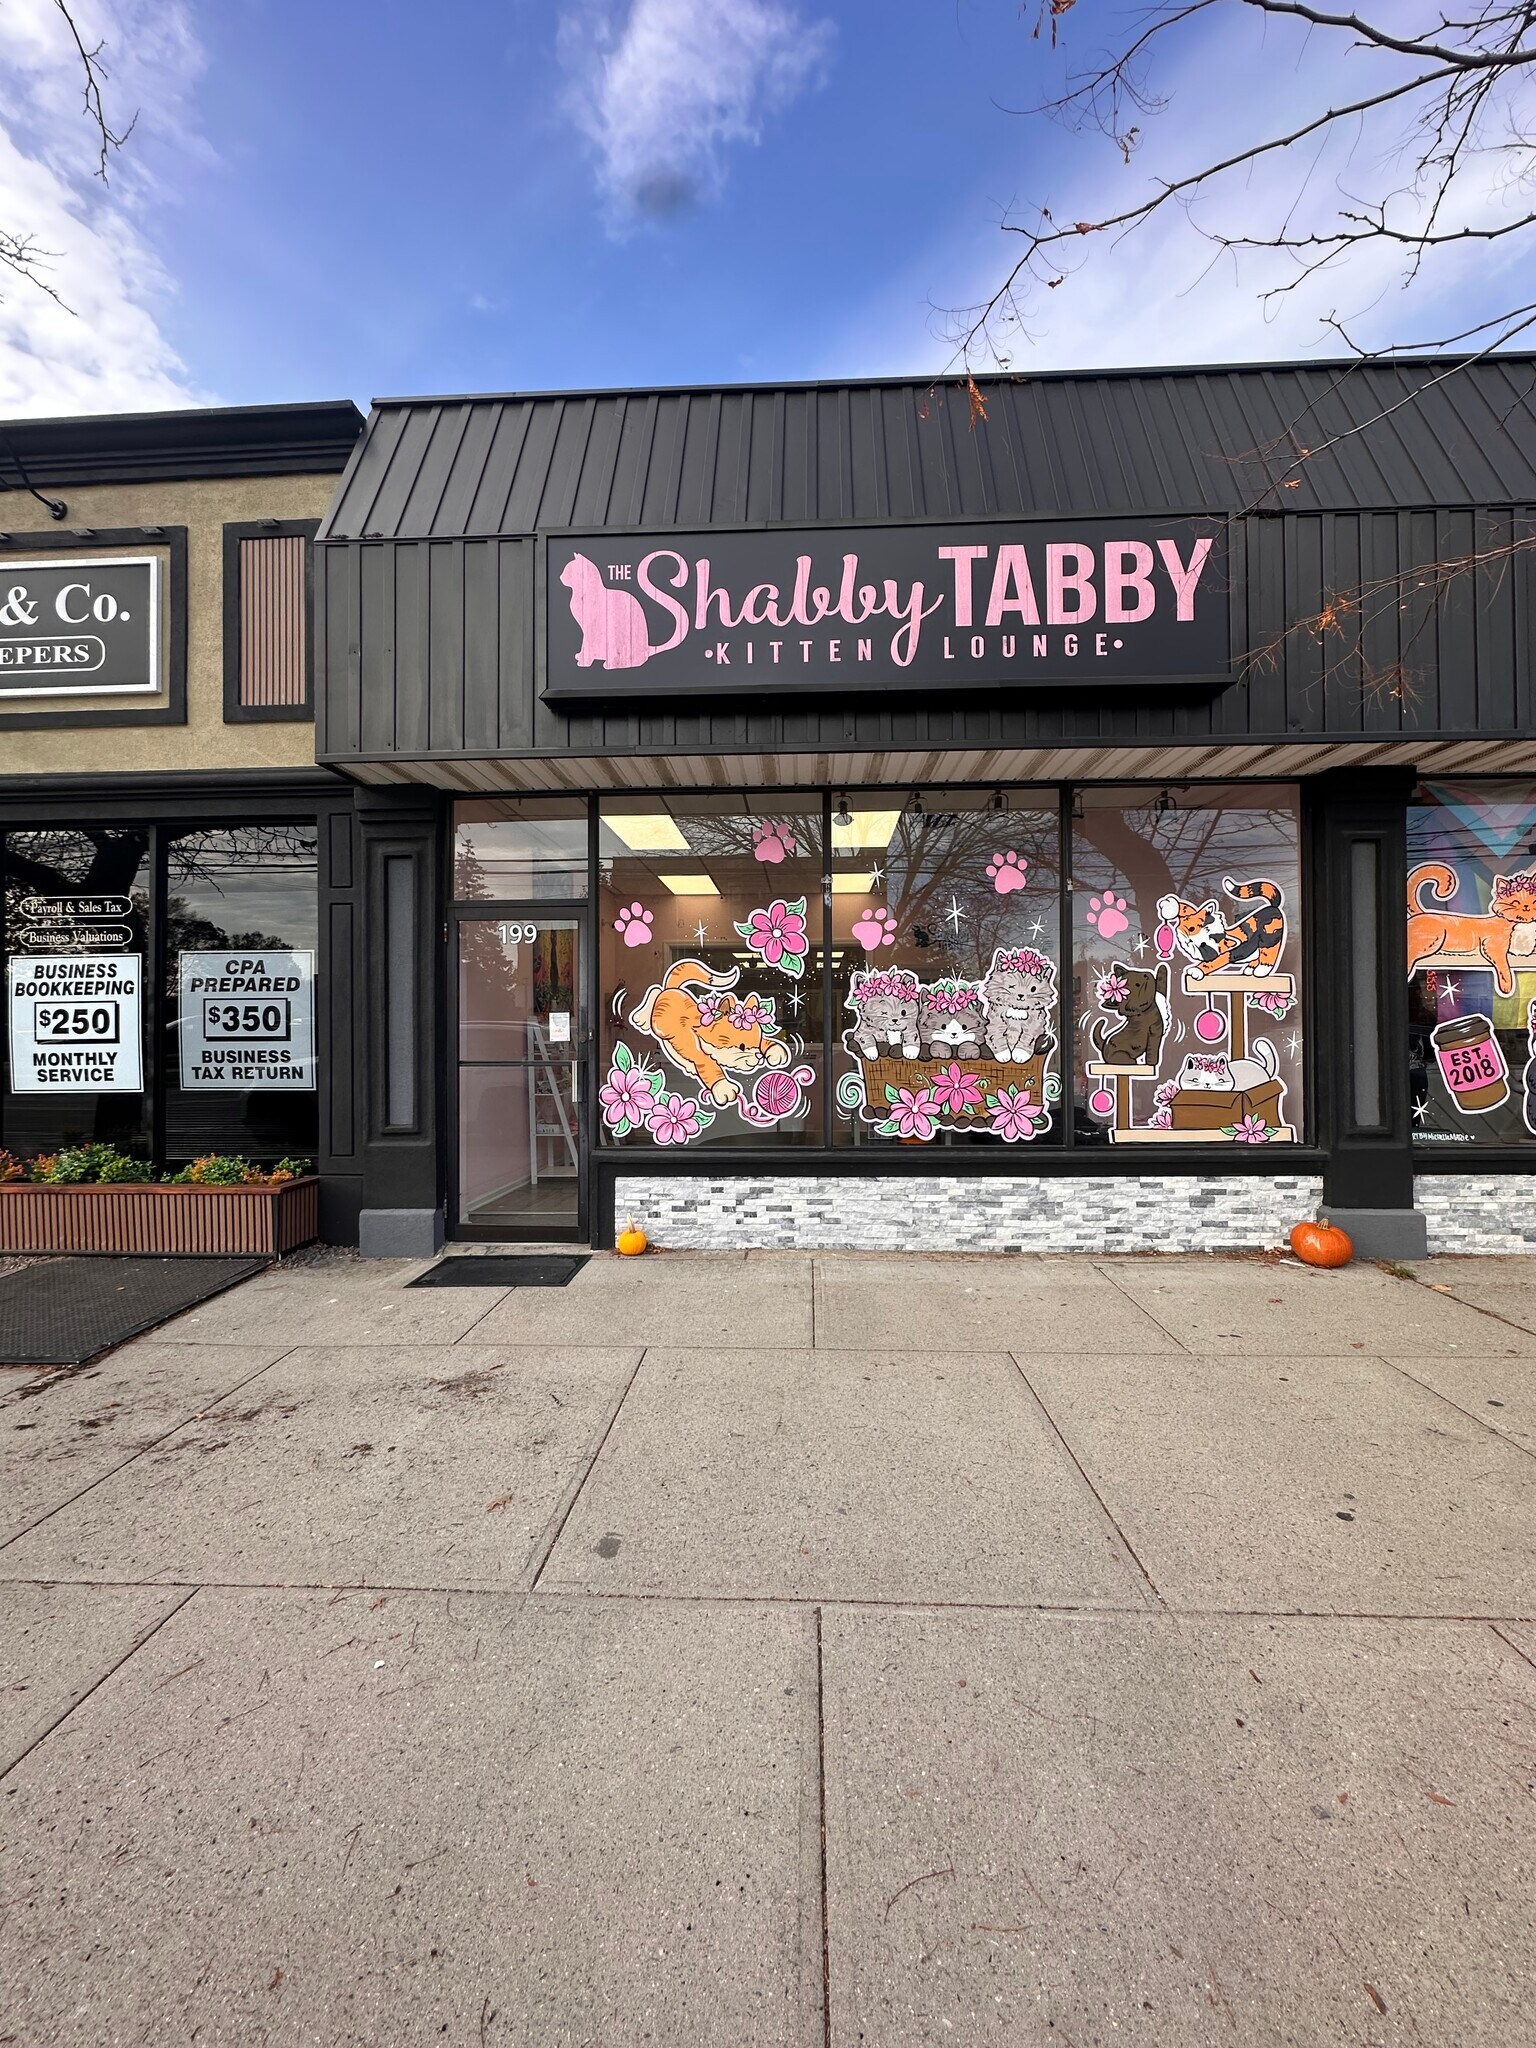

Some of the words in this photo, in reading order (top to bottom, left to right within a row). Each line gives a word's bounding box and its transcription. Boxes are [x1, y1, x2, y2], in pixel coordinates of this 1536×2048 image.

[0, 586, 39, 626] &
[55, 583, 131, 624] Co.
[608, 565, 631, 580] THE
[637, 550, 944, 667] Shabby
[938, 538, 1213, 627] TABBY
[716, 639, 872, 664] KITTEN
[943, 633, 1108, 659] LOUNGE
[31, 901, 63, 914] Payroll
[66, 901, 75, 913] &
[78, 901, 102, 913] Sales
[104, 901, 122, 912] Tax
[29, 931, 70, 943] Business
[73, 930, 124, 943] Valuations
[498, 924, 537, 944] 199
[34, 964, 118, 980] BUSINESS
[225, 960, 266, 975] CPA
[15, 980, 135, 997] BOOKKEEPING
[190, 977, 300, 993] PREPARED
[38, 1008, 110, 1035] $250
[208, 1005, 282, 1032] $350
[33, 1052, 118, 1066] MONTHLY
[202, 1050, 291, 1064] BUSINESS
[1450, 1047, 1489, 1067] EST.
[37, 1068, 115, 1082] SERVICE
[191, 1067, 225, 1080] TAX
[232, 1066, 304, 1080] RETURN
[1449, 1058, 1496, 1086] 2018
